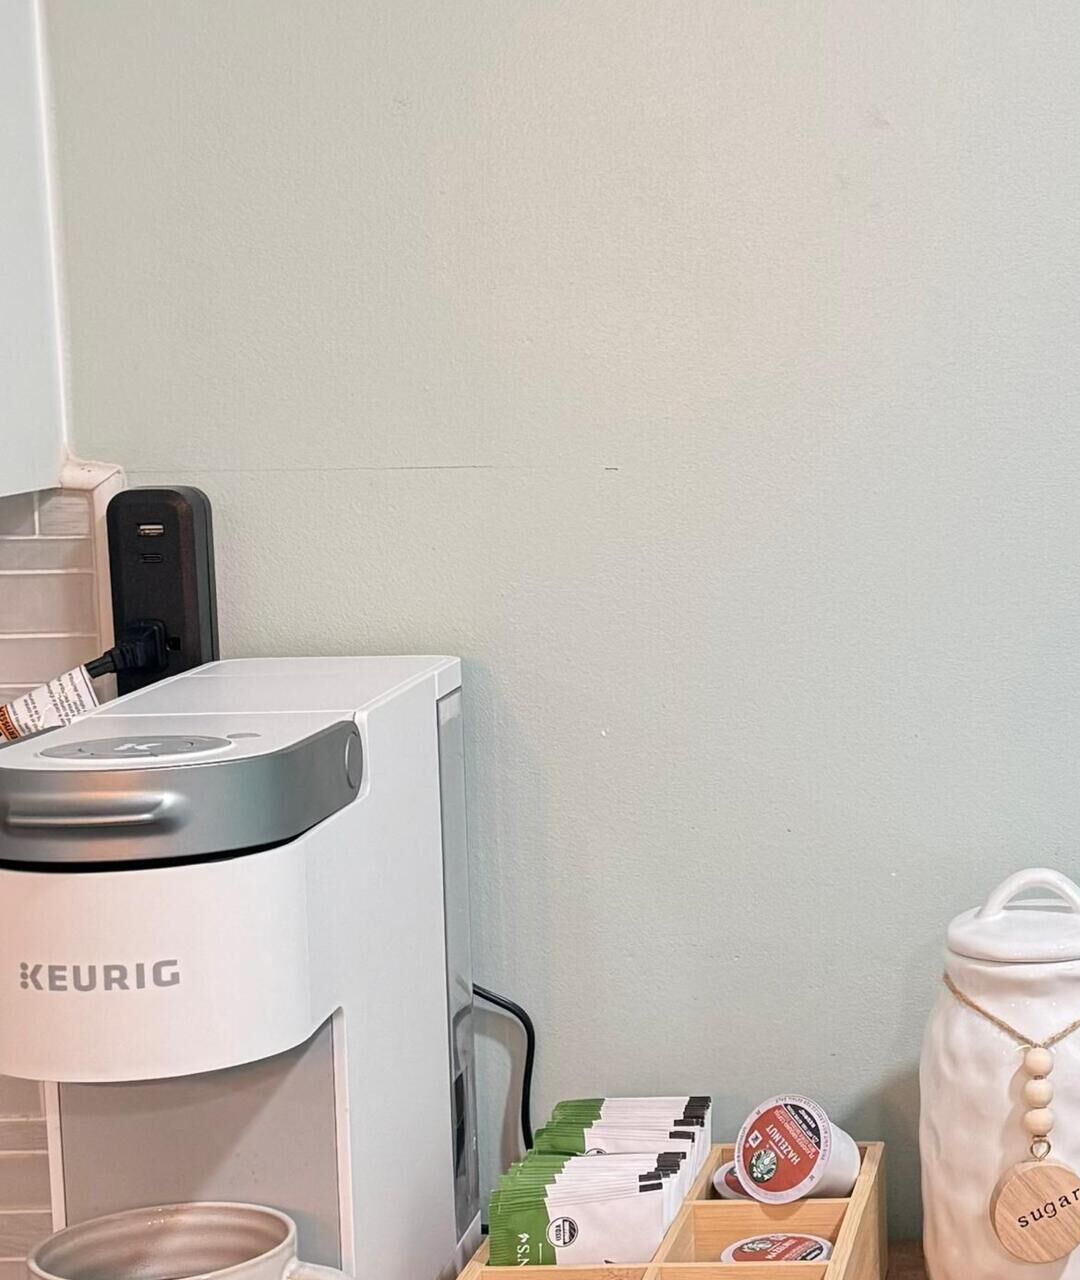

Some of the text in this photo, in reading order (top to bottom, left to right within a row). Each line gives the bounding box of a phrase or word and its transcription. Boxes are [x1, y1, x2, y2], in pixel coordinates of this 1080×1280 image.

[20, 959, 180, 992] KEURIG
[765, 1124, 801, 1165] HAZELNUT
[1017, 1188, 1080, 1228] sugar
